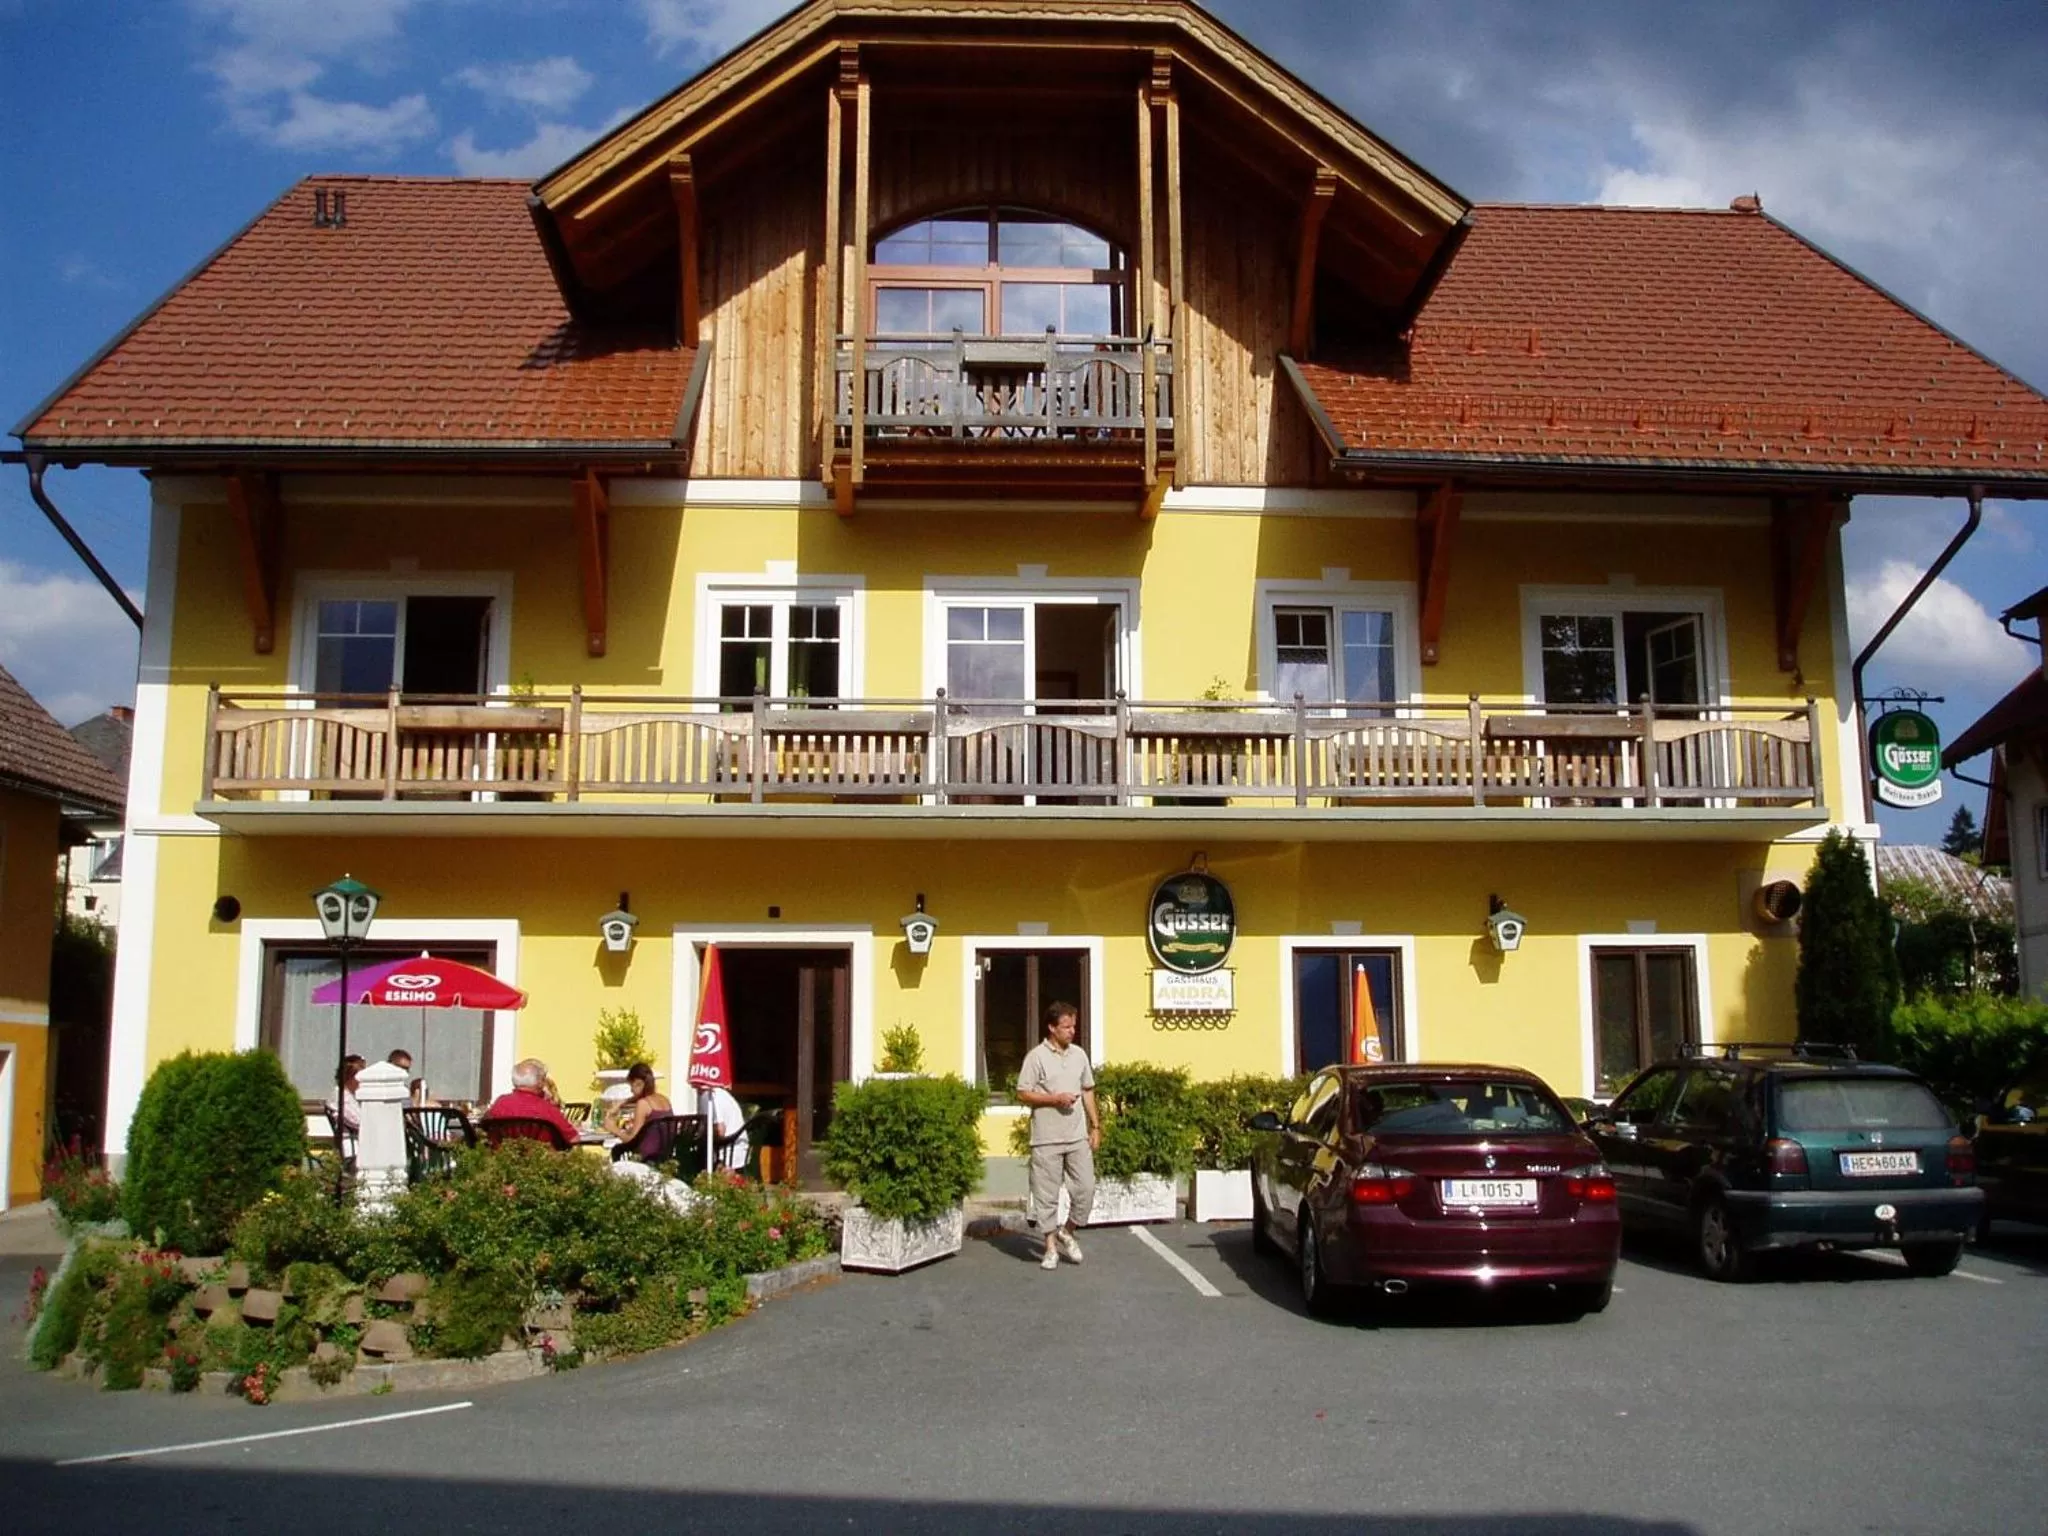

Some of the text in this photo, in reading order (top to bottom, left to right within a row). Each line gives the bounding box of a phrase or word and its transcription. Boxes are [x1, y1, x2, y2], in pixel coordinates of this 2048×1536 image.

[1884, 742, 1933, 772] Gösser
[1154, 902, 1230, 939] Gösser
[384, 990, 437, 1002] ESKIMO
